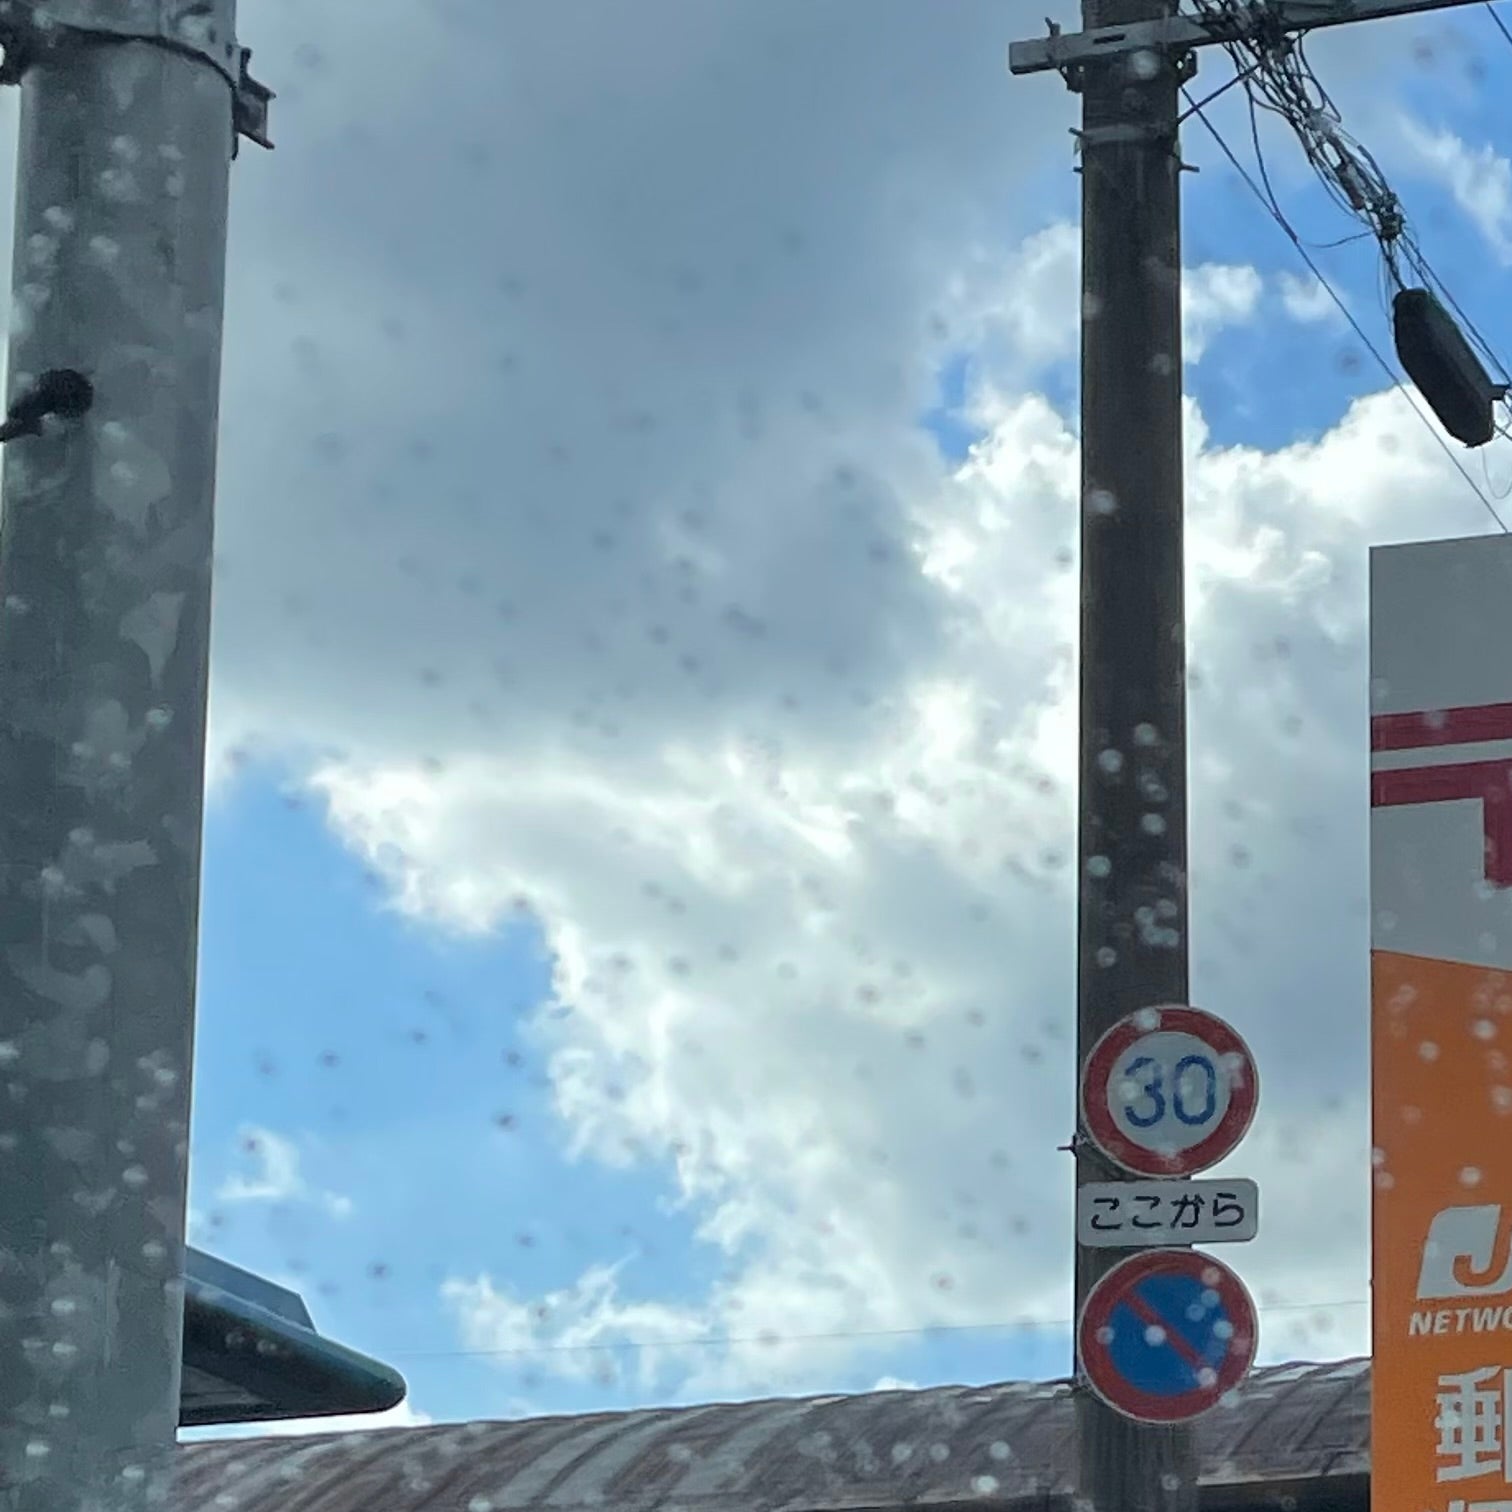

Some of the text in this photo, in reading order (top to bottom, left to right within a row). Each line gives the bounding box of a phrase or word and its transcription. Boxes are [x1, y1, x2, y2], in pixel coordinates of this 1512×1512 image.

[1125, 1055, 1217, 1128] 30
[1091, 1193, 1246, 1230] ここから
